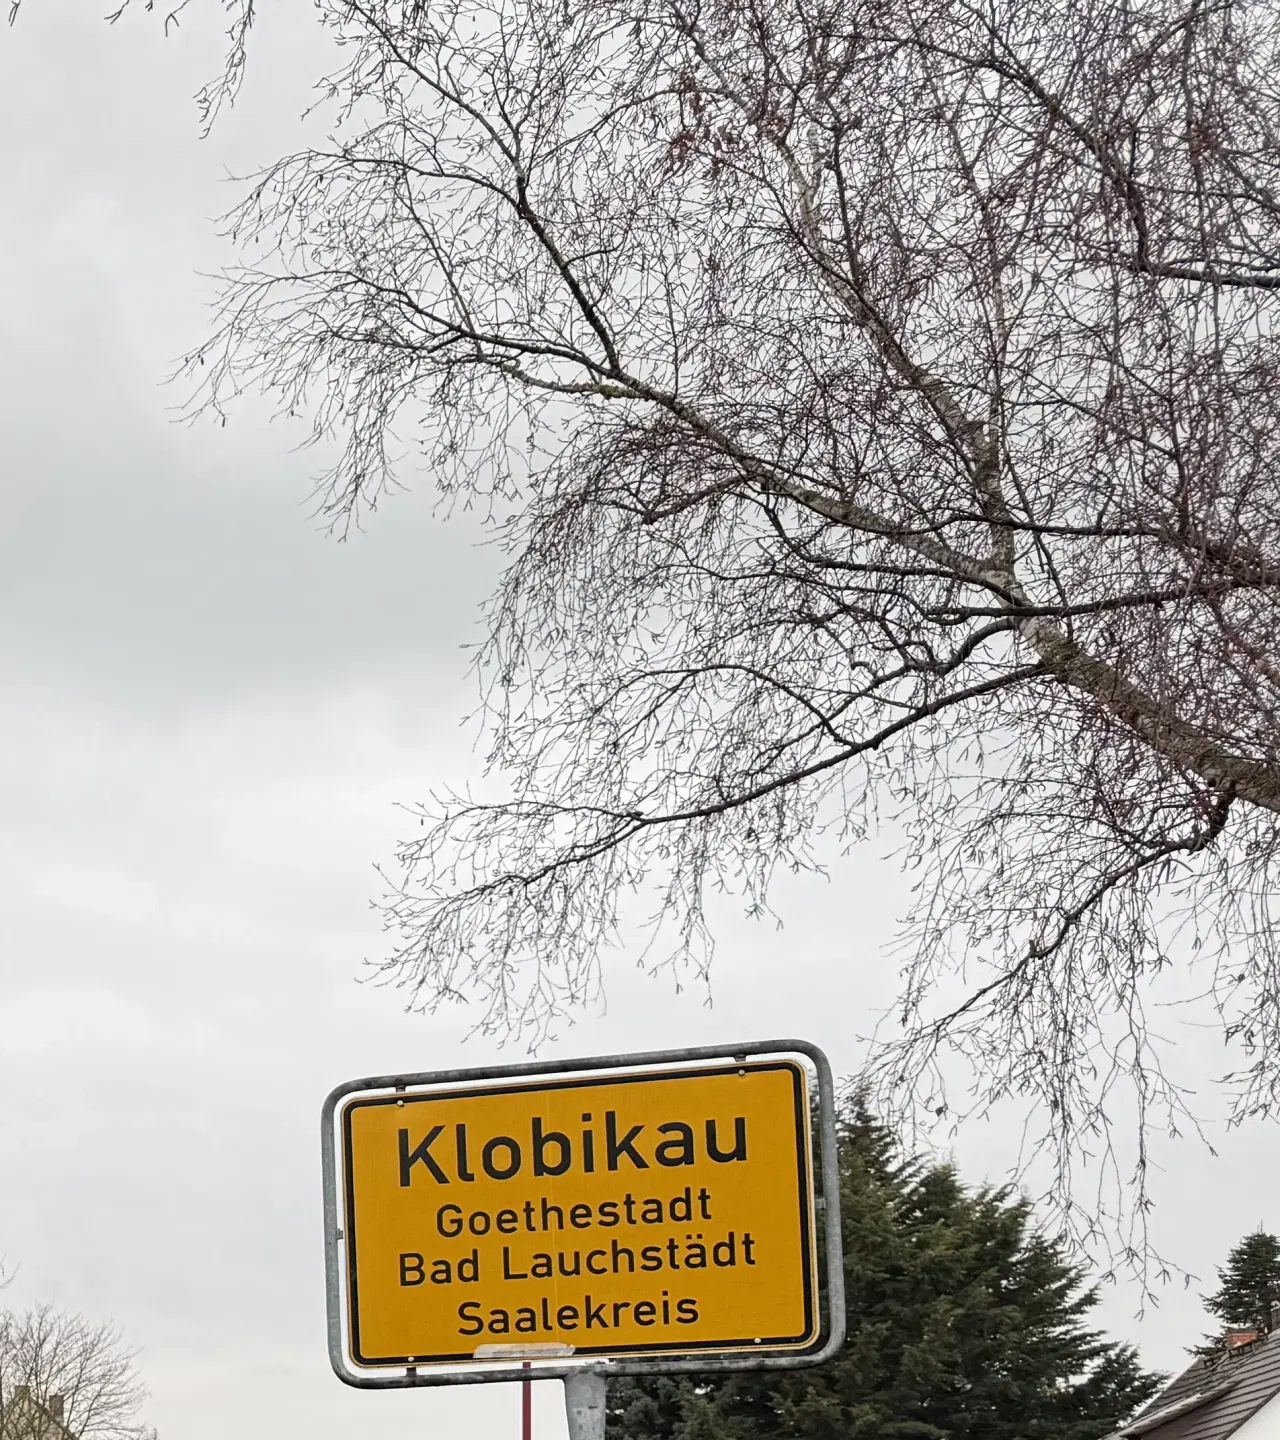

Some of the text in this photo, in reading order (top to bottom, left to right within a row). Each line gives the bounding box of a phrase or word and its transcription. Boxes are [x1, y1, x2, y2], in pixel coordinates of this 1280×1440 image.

[398, 1110, 748, 1188] Klobikau
[436, 1186, 713, 1239] Goethestadt
[399, 1231, 757, 1288] Bad Lauchstädt
[457, 1290, 700, 1336] Saalekreis
